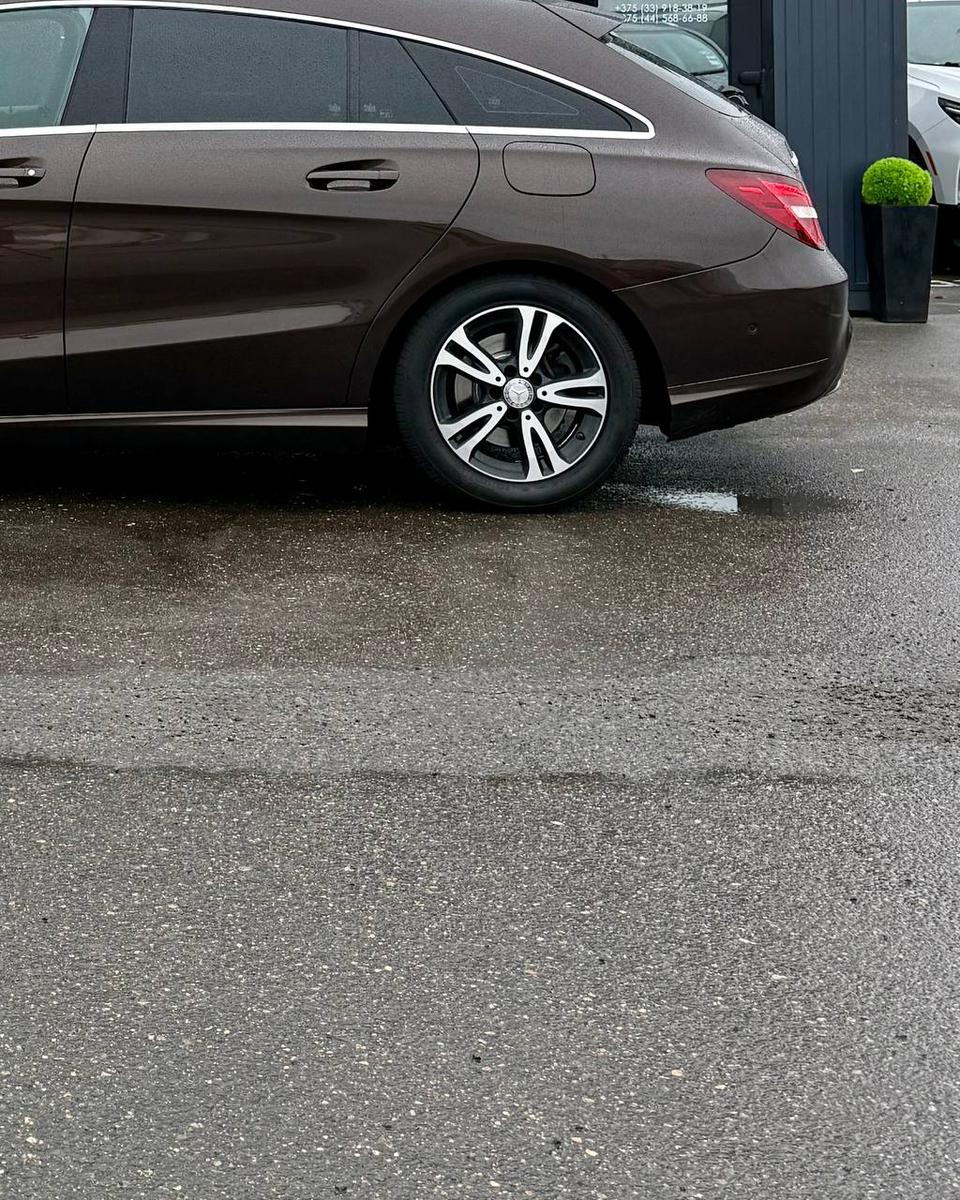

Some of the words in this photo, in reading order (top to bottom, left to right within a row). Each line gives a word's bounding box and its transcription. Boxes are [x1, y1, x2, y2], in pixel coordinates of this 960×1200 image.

[615, 3, 638, 13] +375
[641, 3, 658, 14] (33)
[661, 3, 707, 13] 918-38-19
[641, 13, 658, 24] (44)
[661, 13, 708, 23] 568-66-88
